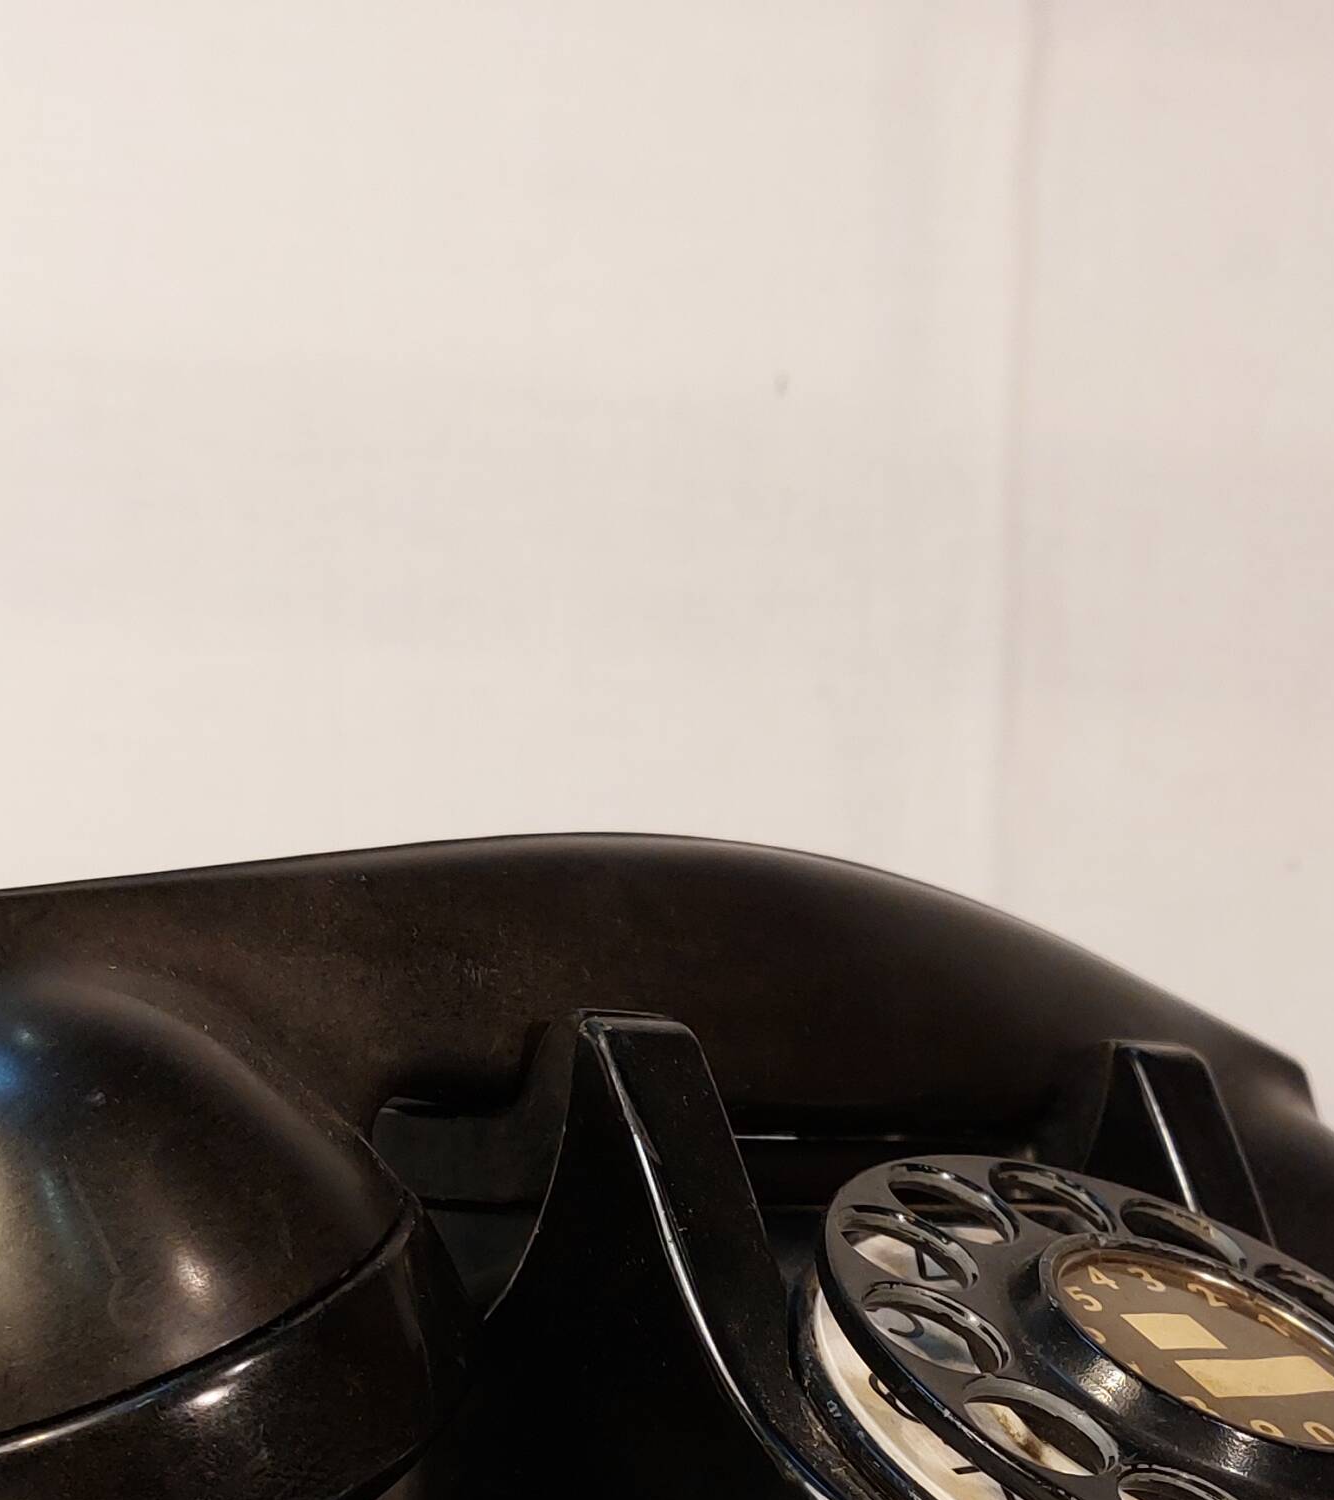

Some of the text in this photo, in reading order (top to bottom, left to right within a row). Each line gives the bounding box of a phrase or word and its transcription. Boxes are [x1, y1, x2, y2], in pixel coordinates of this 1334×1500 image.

[1087, 1265, 1120, 1290] 4
[1127, 1267, 1167, 1293] 3
[1064, 1286, 1103, 1312] 5
[1187, 1282, 1229, 1308] 2
